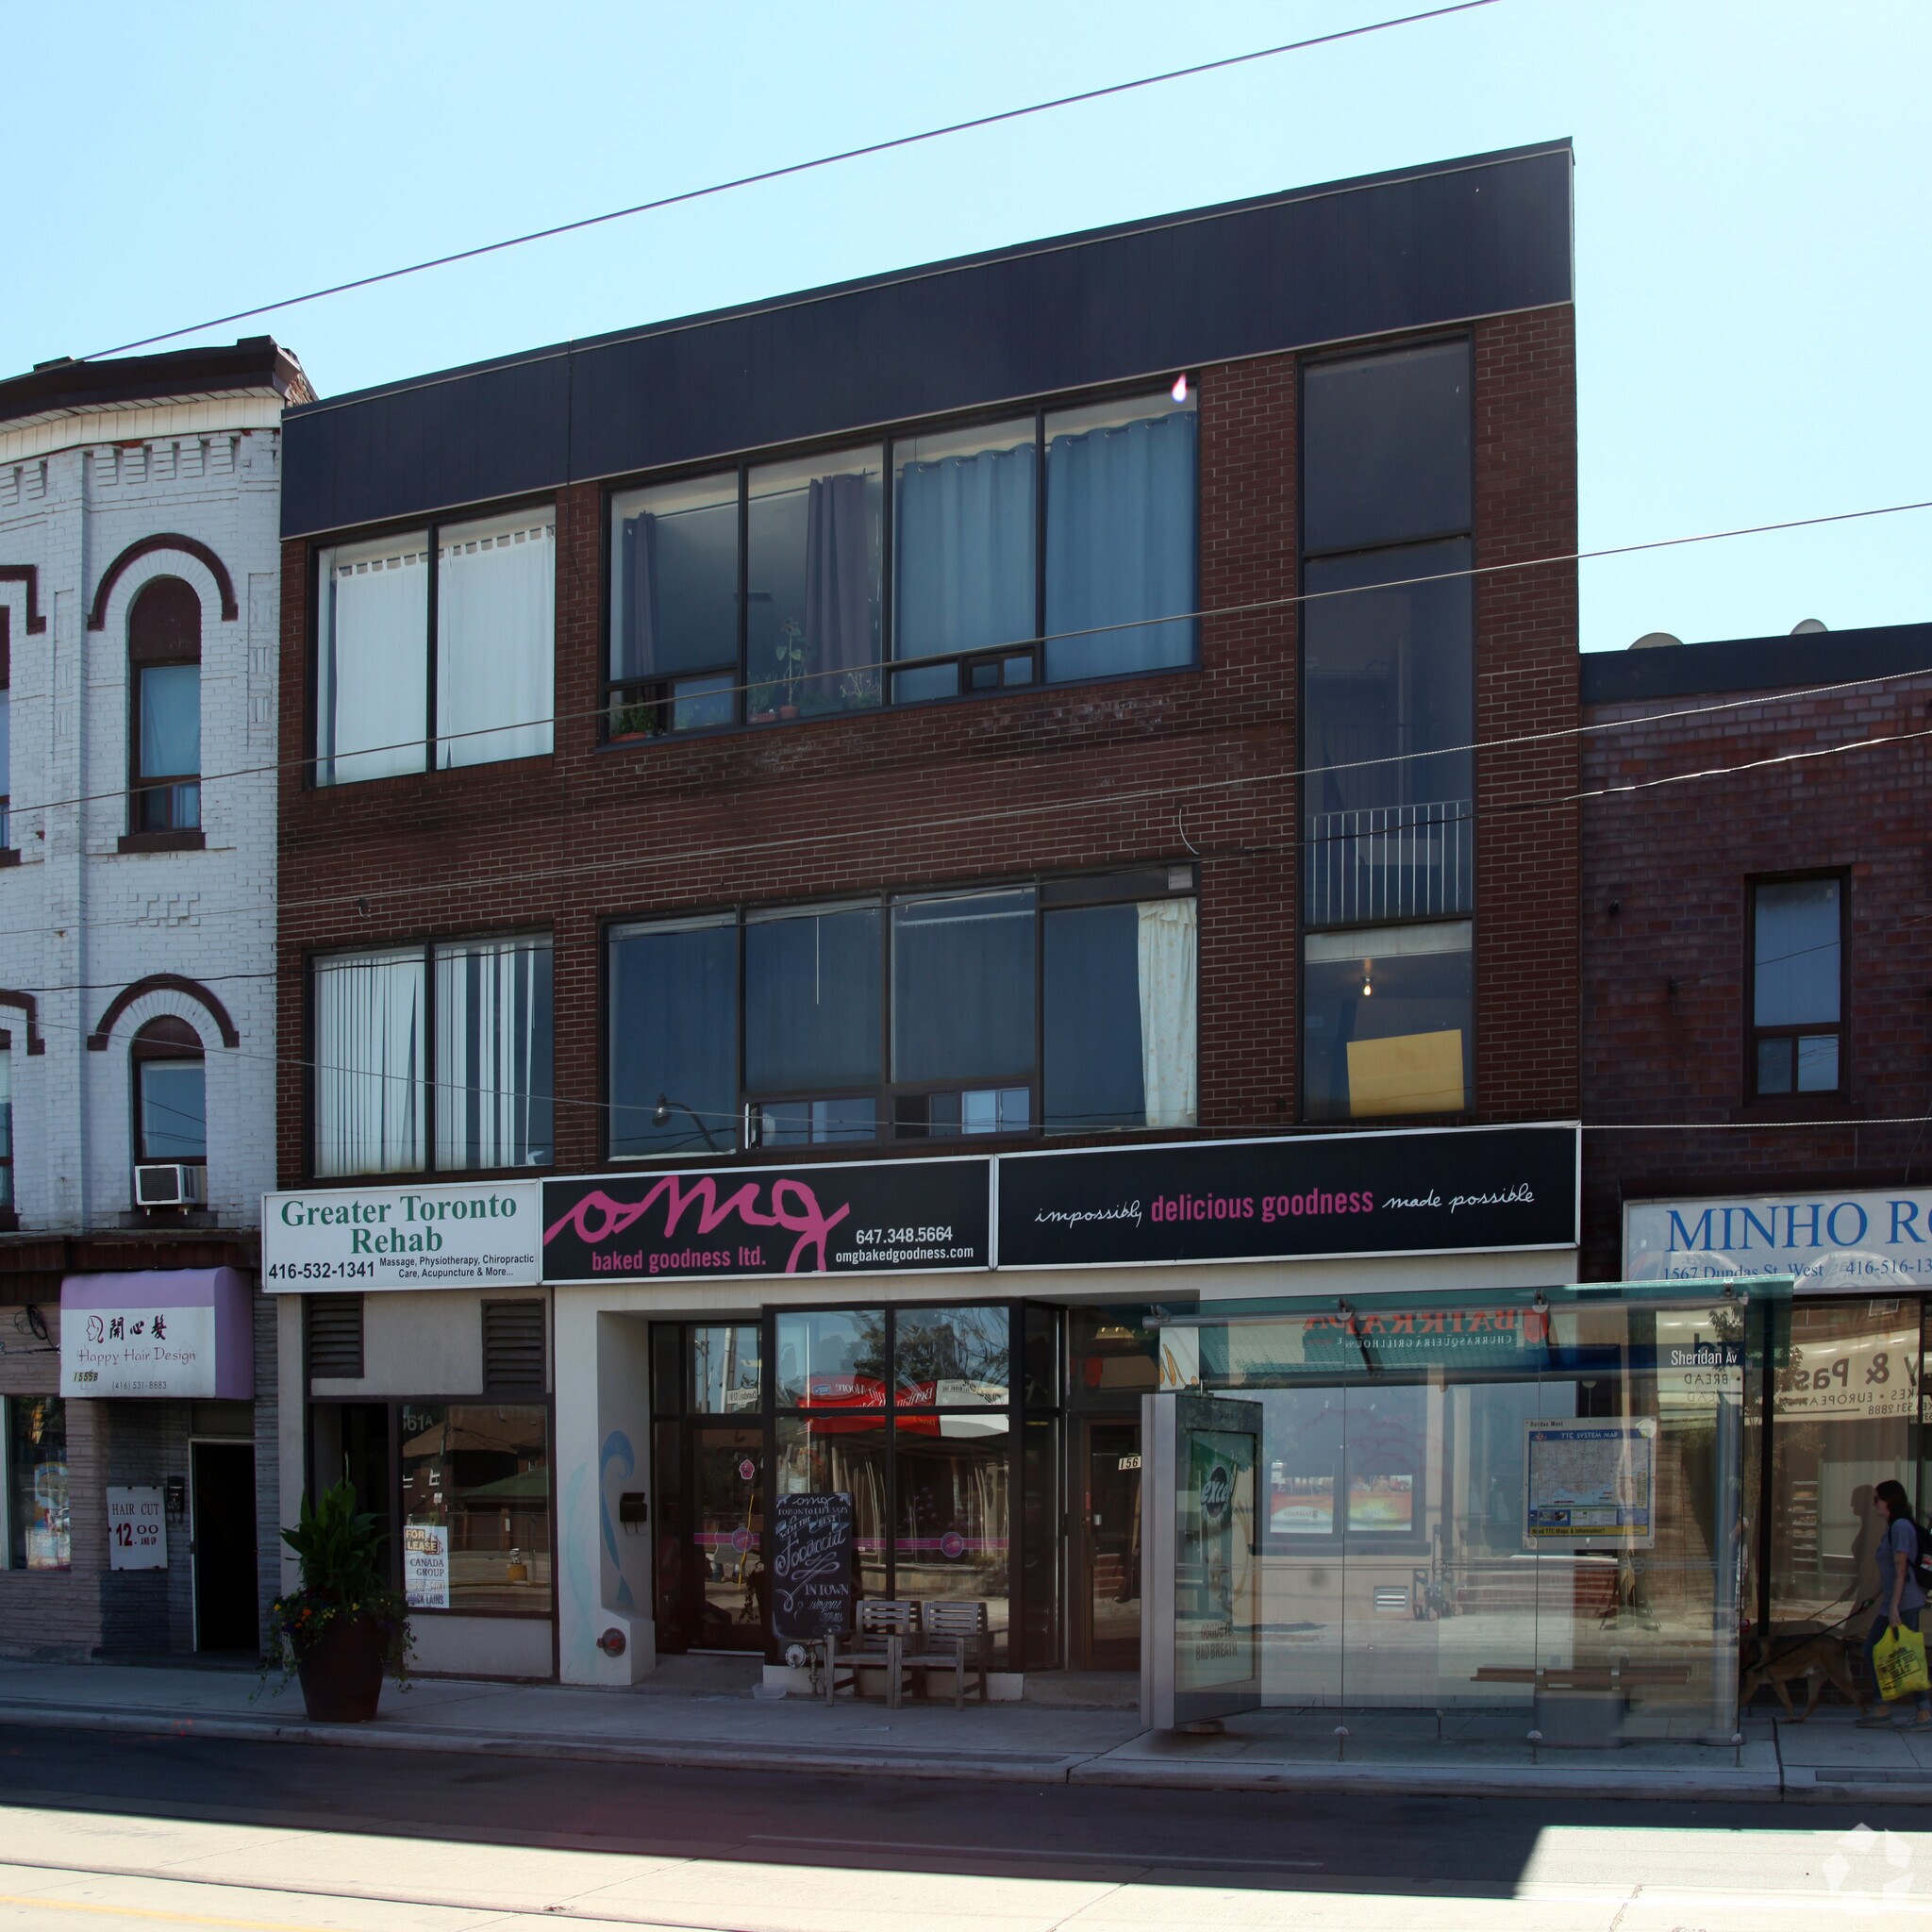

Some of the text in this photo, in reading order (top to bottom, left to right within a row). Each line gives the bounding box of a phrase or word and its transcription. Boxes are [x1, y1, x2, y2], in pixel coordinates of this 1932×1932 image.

[281, 1192, 517, 1226] Greater Toronto
[1035, 1182, 1535, 1229] impossibly delicious goodness made possible
[543, 1175, 850, 1274] omg
[1665, 1200, 1932, 1253] MINHO R
[350, 1225, 443, 1255] Rehab
[856, 1225, 953, 1244] 647.348.5664
[379, 1254, 535, 1268] Massage, Physiotherapy, Chiropractic
[591, 1245, 766, 1273] baked goodness ltd.
[836, 1246, 974, 1265] omgbakedgoodness.com
[268, 1261, 375, 1279] 416-532-1341
[398, 1266, 514, 1278] Care, Acupuncture & More...
[1663, 1266, 1698, 1280] 1567
[1788, 1262, 1824, 1277] West
[78, 1346, 196, 1366] Happy Hair Design
[1671, 1348, 1738, 1365] Sheridan Av
[111, 1381, 131, 1391] (416)
[132, 1380, 168, 1391] 531-8883
[112, 1503, 160, 1516] HAIR CUT
[141, 1537, 150, 1545] AND
[405, 1529, 425, 1540] FOR
[407, 1541, 437, 1552] LEASE
[409, 1558, 444, 1567] CANADA
[416, 1568, 444, 1577] GROUP
[805, 1583, 849, 1595] IN TOWN
